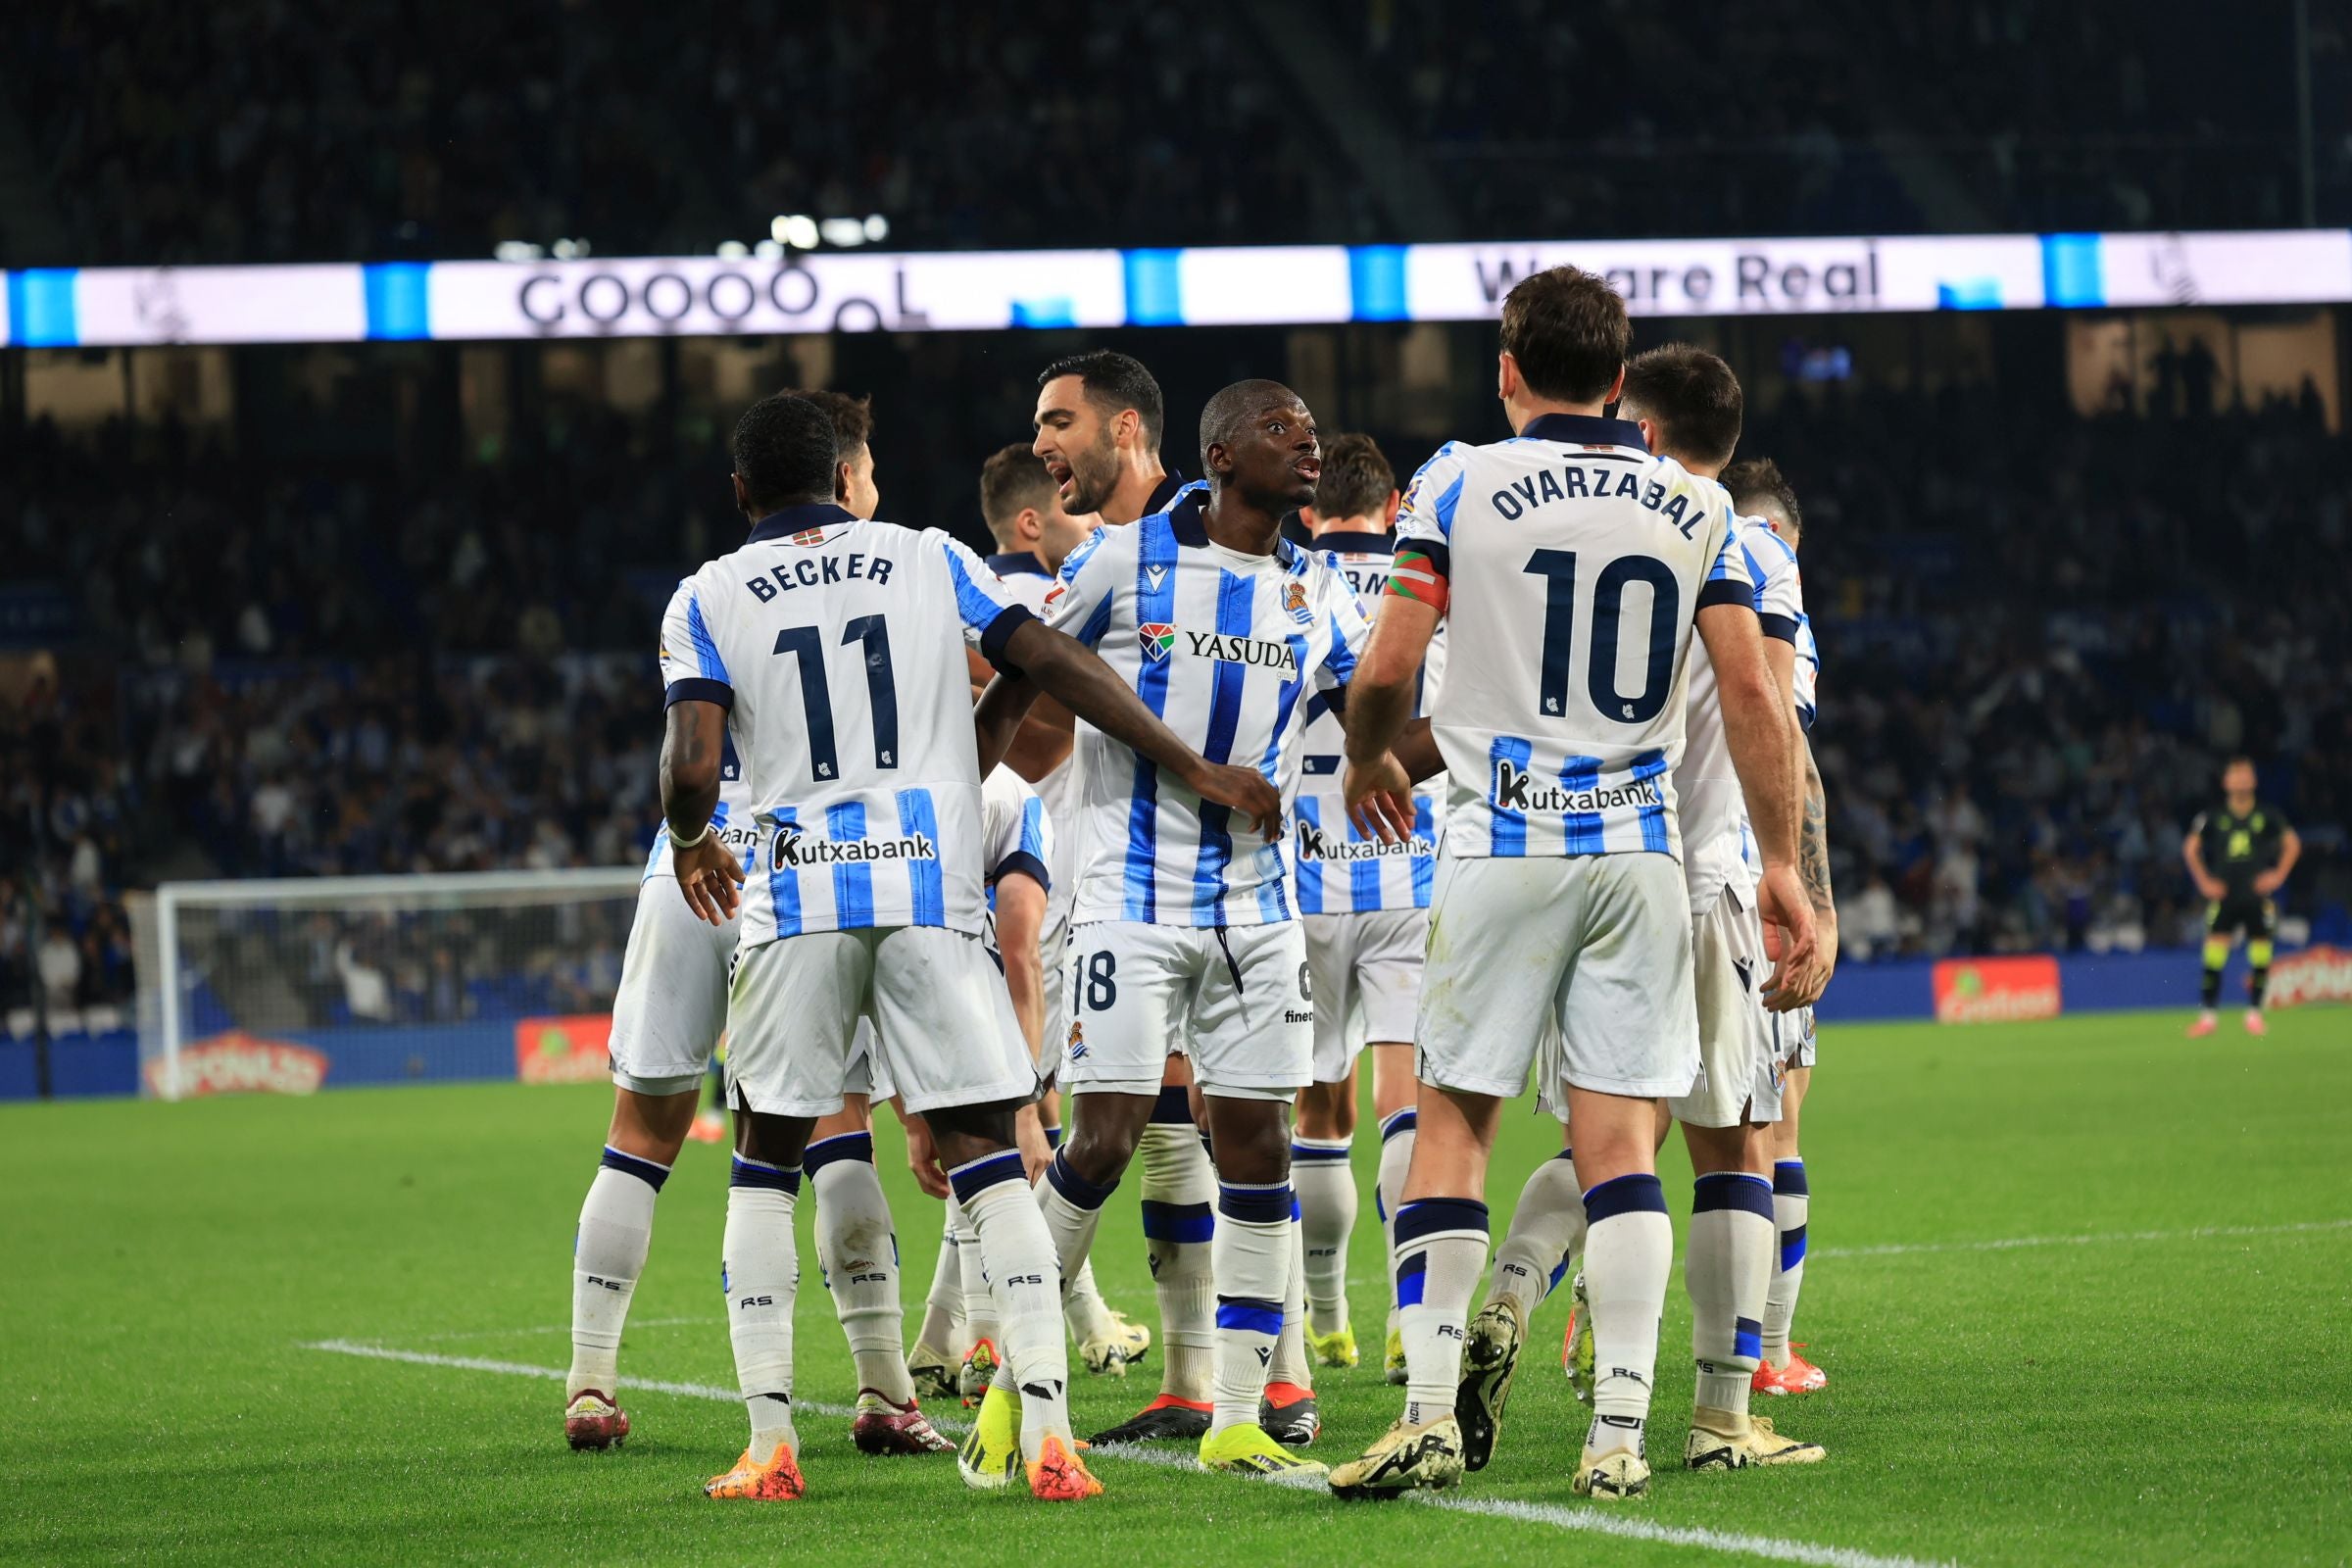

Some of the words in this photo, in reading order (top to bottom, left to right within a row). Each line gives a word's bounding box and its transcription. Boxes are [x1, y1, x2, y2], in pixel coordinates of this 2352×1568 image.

[1475, 258, 1537, 304] W
[1606, 266, 1713, 301] are
[1737, 241, 1882, 300] Real
[1492, 466, 1707, 541] OYARZABAL
[747, 554, 893, 604] BECKER
[1346, 570, 1389, 595] RM
[1186, 631, 1297, 670] YASUDA
[1523, 548, 1680, 724] 10
[772, 613, 899, 782] 11
[1499, 762, 1657, 810] Kutxabank
[774, 828, 934, 868] Kutxabank
[1300, 822, 1431, 859] Kutxabank
[1073, 950, 1116, 1016] 18
[1285, 1009, 1313, 1023] finet
[588, 1275, 621, 1291] RS
[852, 1273, 887, 1285] RS
[1007, 1274, 1043, 1288] RS
[1502, 1263, 1528, 1277] RS
[741, 1295, 773, 1310] RS
[1437, 1324, 1463, 1341] RS
[1612, 1367, 1642, 1381] RS
[1695, 1359, 1714, 1374] RS
